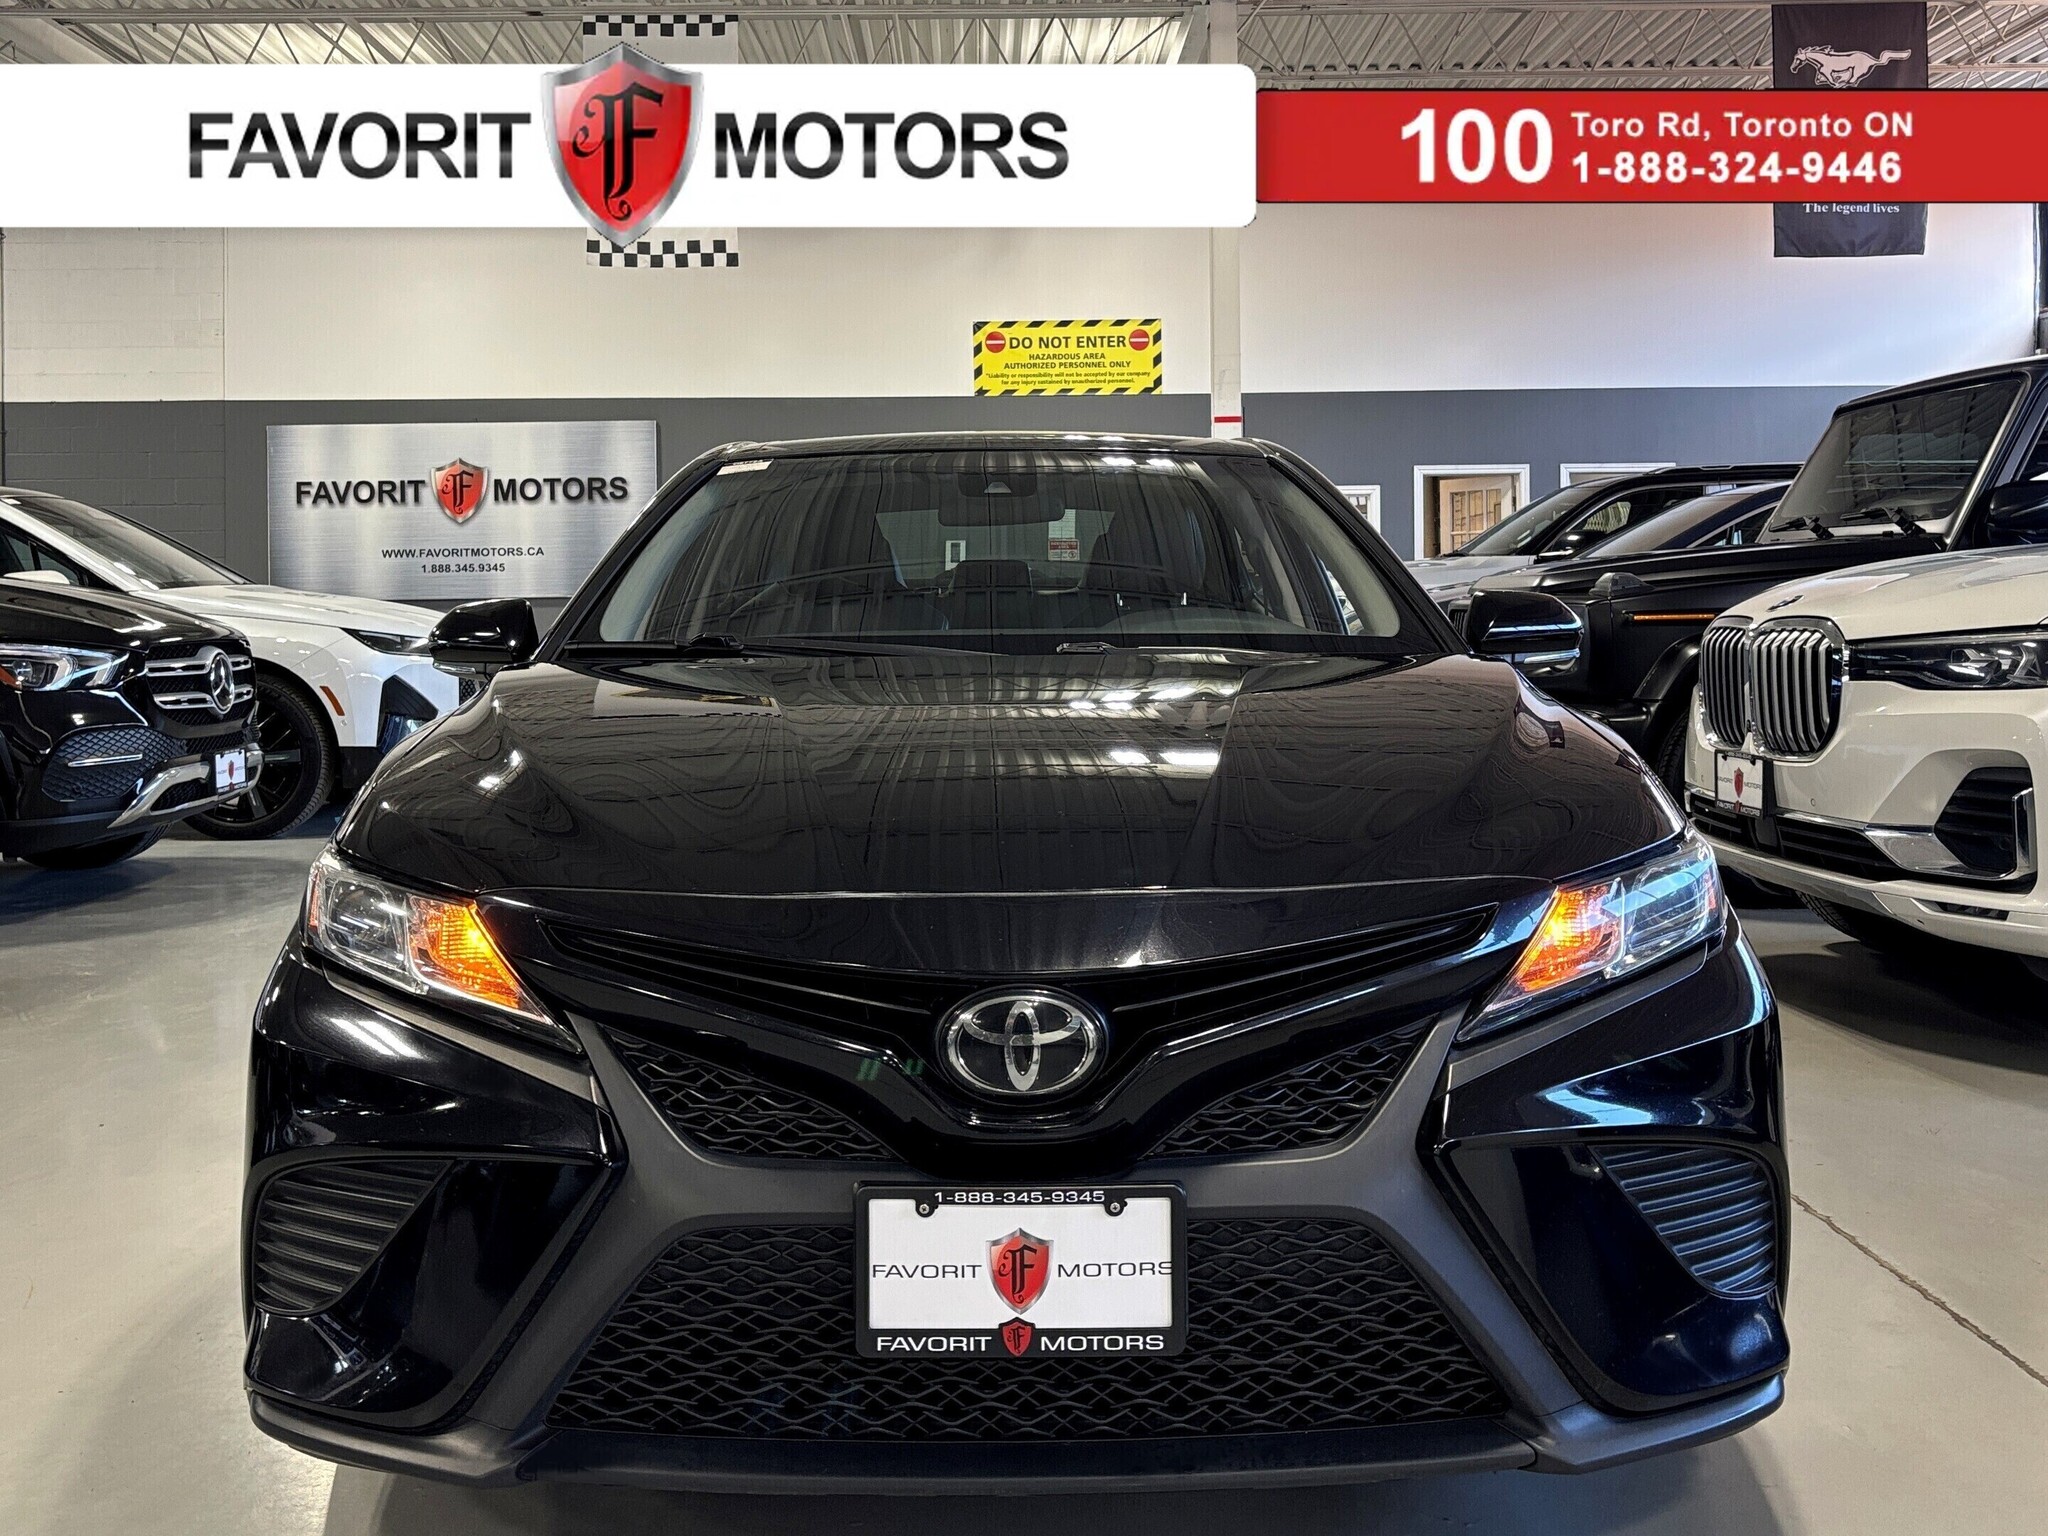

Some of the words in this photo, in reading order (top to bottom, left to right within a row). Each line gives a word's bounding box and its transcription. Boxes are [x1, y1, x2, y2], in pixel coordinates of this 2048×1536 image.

[1803, 203, 1829, 213] The
[1832, 203, 1870, 215] legend
[1873, 203, 1900, 213] lives
[1009, 337, 1033, 349] DO
[1038, 336, 1071, 349] NOT
[1076, 335, 1127, 348] ENTER
[1028, 353, 1081, 361] HAZARDOUS
[1083, 352, 1106, 360] AREA
[1004, 362, 1056, 370] AUTHORIZED
[1058, 361, 1106, 369] PERSONNEL
[295, 480, 425, 505] FAVORIT
[493, 476, 629, 503] MOTORS
[382, 547, 545, 559] WWW.FAVORITMOTORS.CA
[421, 563, 506, 574] 1.888.345.9345
[934, 1191, 1106, 1204] 1-888-345-9345
[872, 1264, 982, 1279] FAVORIT
[1058, 1261, 1173, 1278] MOTORS
[876, 1336, 993, 1352] FAVORIT
[1040, 1335, 1165, 1351] MOTORS
